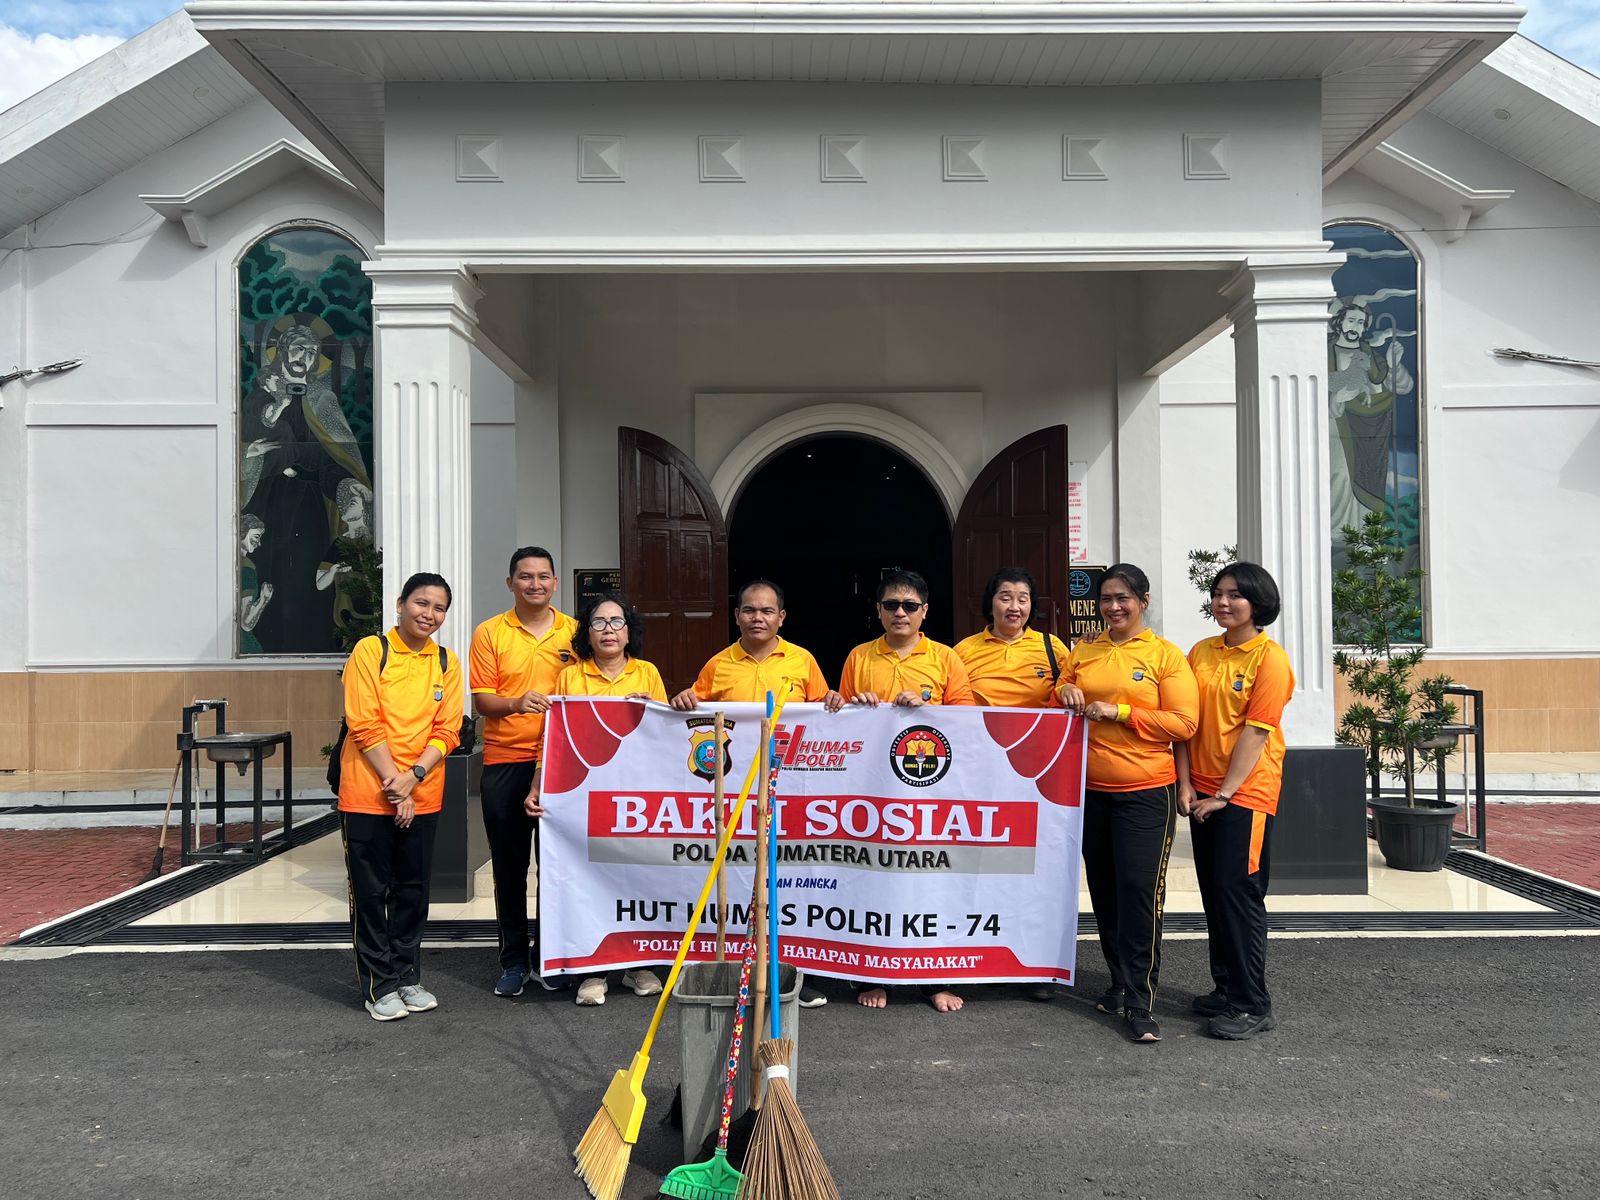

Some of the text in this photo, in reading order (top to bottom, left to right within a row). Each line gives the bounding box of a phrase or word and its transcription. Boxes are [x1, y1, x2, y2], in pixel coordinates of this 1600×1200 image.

[799, 741, 864, 755] HUMAS
[795, 754, 846, 768] POLRI
[805, 799, 1011, 842] SOSIAL
[878, 849, 951, 868] UTARA
[795, 877, 838, 890] RANGKA
[616, 899, 677, 922] HUT
[687, 902, 797, 926] HUMS
[807, 904, 891, 937] POLRI
[902, 913, 938, 938] KE
[966, 914, 1001, 937] 74
[782, 944, 860, 966] HARAPAN
[864, 954, 984, 970] MASYARAKAT"
